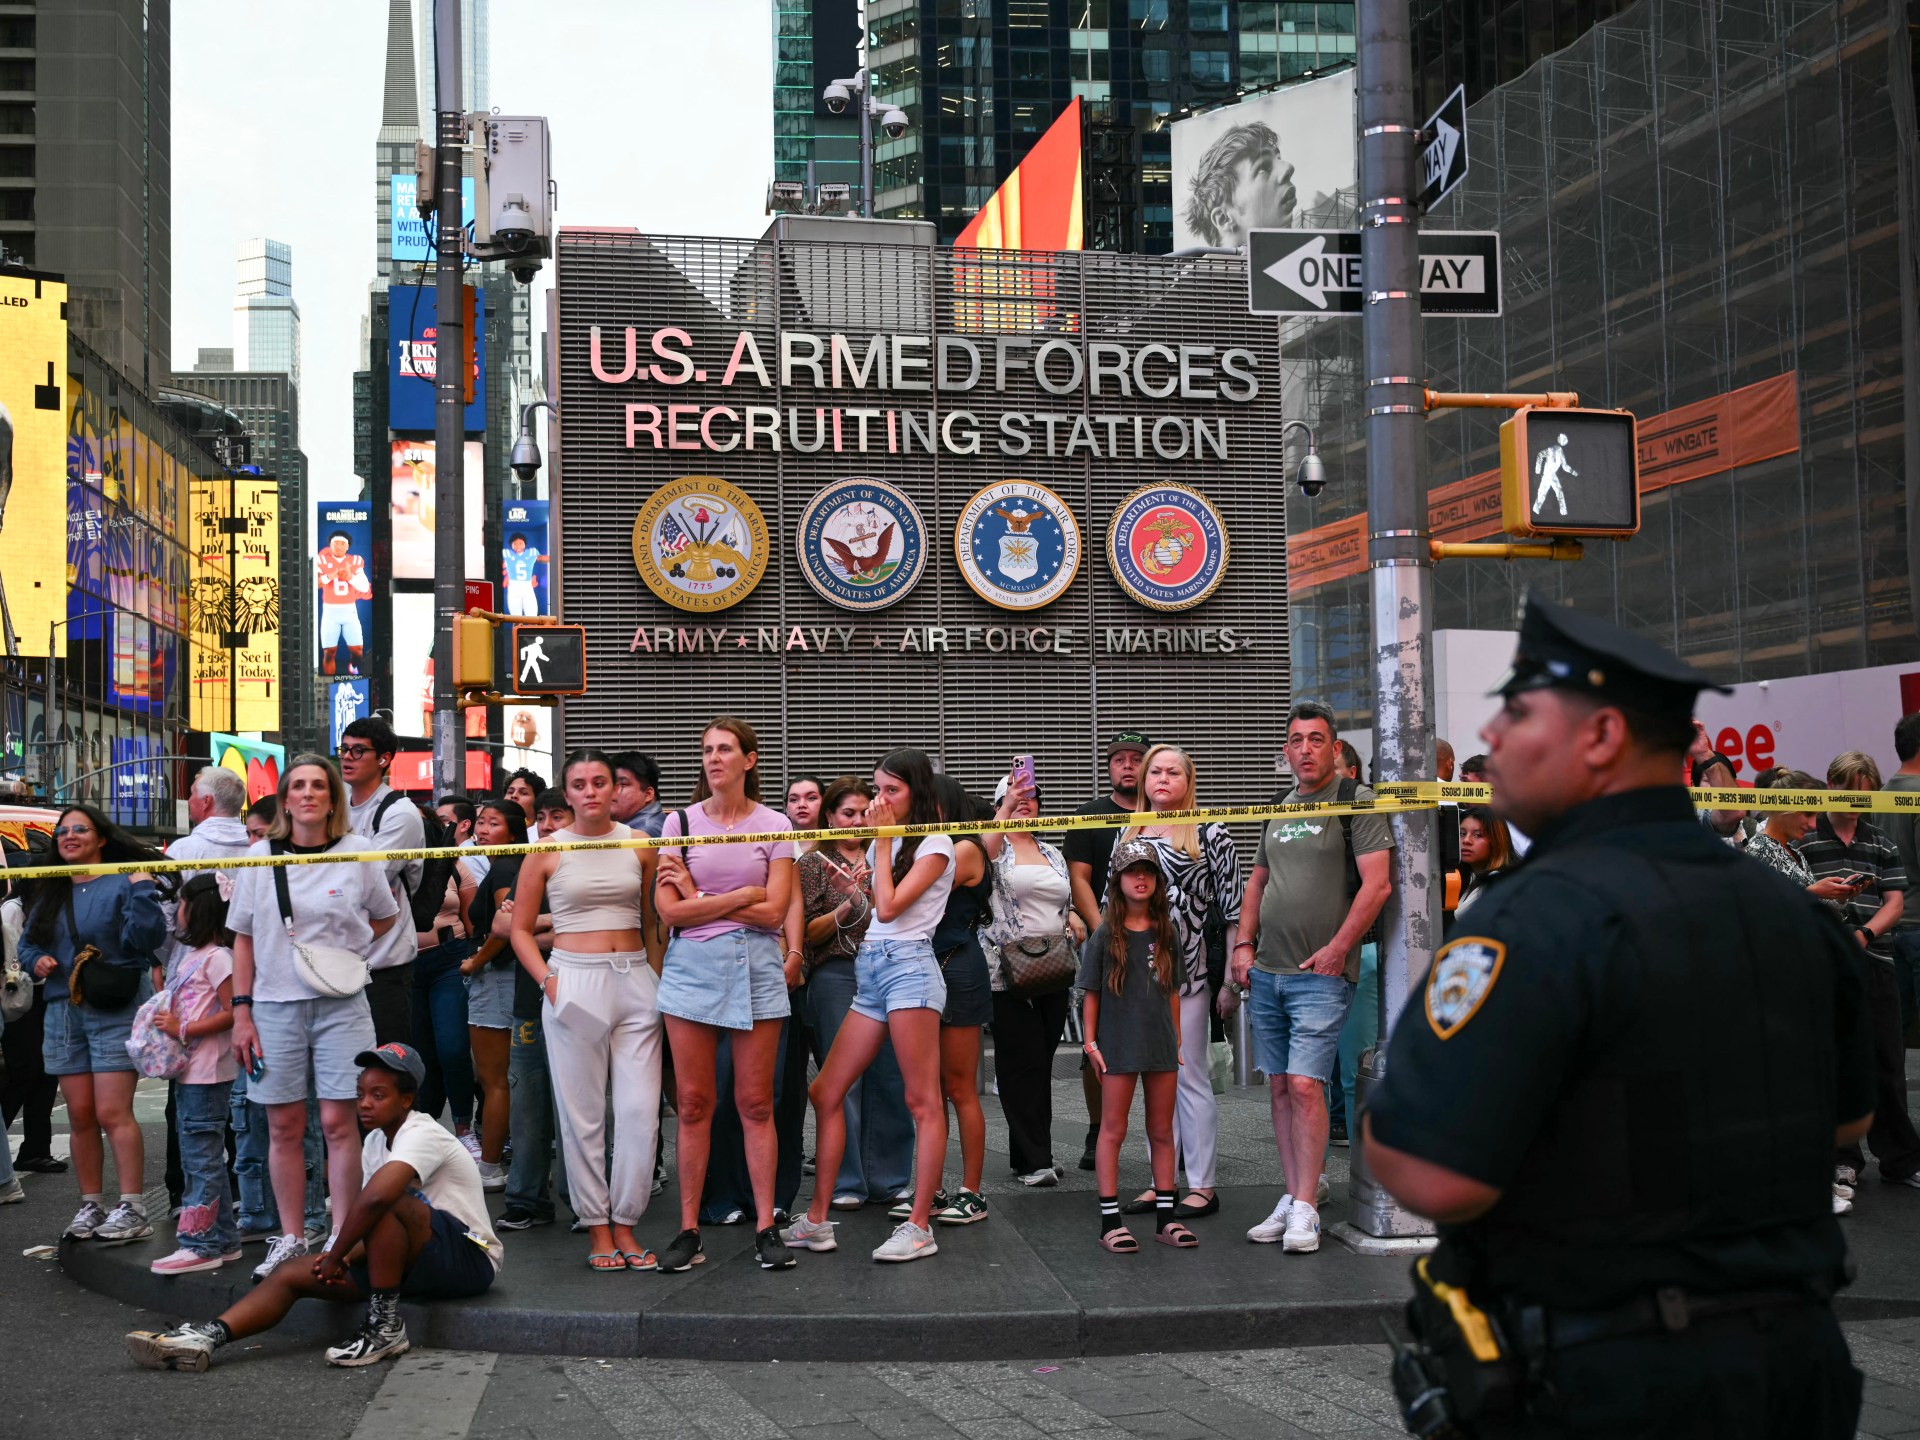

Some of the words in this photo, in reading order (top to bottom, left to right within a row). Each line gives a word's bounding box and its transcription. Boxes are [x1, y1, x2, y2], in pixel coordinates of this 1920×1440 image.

[1421, 133, 1448, 184] WAY
[1299, 257, 1363, 288] ONE
[1419, 258, 1471, 289] AY
[590, 326, 707, 385] U.S.
[721, 330, 982, 390] ARMED
[996, 337, 1259, 401] FORCES
[625, 403, 982, 455] RECRUITING
[998, 411, 1229, 460] STATION
[1664, 427, 1717, 455] WINGATE
[252, 491, 261, 504] It
[641, 482, 700, 533] DEPARTMENT
[707, 483, 721, 493] OF
[727, 490, 746, 508] THE
[746, 511, 764, 544] ARMY
[251, 524, 262, 537] in
[809, 490, 856, 541] DEPARTMENT
[860, 490, 874, 499] OF
[879, 493, 897, 510] THE
[896, 508, 914, 533] NAVY
[960, 490, 995, 562] DEPARTMENT
[1001, 485, 1018, 495] OF
[1025, 486, 1049, 503] THE
[1052, 505, 1069, 524] AIR
[1065, 531, 1077, 571] FORCE
[1118, 493, 1166, 547] DEPARTMENT
[1169, 495, 1179, 503] OF
[1182, 497, 1198, 511] THE
[1198, 510, 1218, 539] NAVY
[243, 540, 266, 554] You
[640, 544, 663, 587] UNITED
[664, 587, 708, 607] STATES
[713, 594, 728, 606] OF
[730, 553, 763, 598] AMERICA
[809, 552, 836, 588] UNITED
[835, 586, 871, 599] STATES
[873, 586, 887, 597] OF
[890, 549, 916, 590] AMERICA
[1121, 556, 1144, 587] UNITED
[1145, 586, 1174, 598] STATES
[1177, 576, 1207, 597] MARINE
[1205, 549, 1218, 576] CORPS
[629, 627, 727, 652] ARMY
[758, 626, 856, 652] NAVY
[900, 626, 949, 652] AIR
[964, 627, 1073, 653] FORCE
[1106, 628, 1236, 653] MARINES
[239, 666, 275, 679] Today.
[241, 651, 260, 663] See
[264, 651, 272, 663] it
[1718, 793, 1736, 803] SCENE
[1738, 794, 1757, 803] CRIME
[1126, 842, 1147, 856] NY
